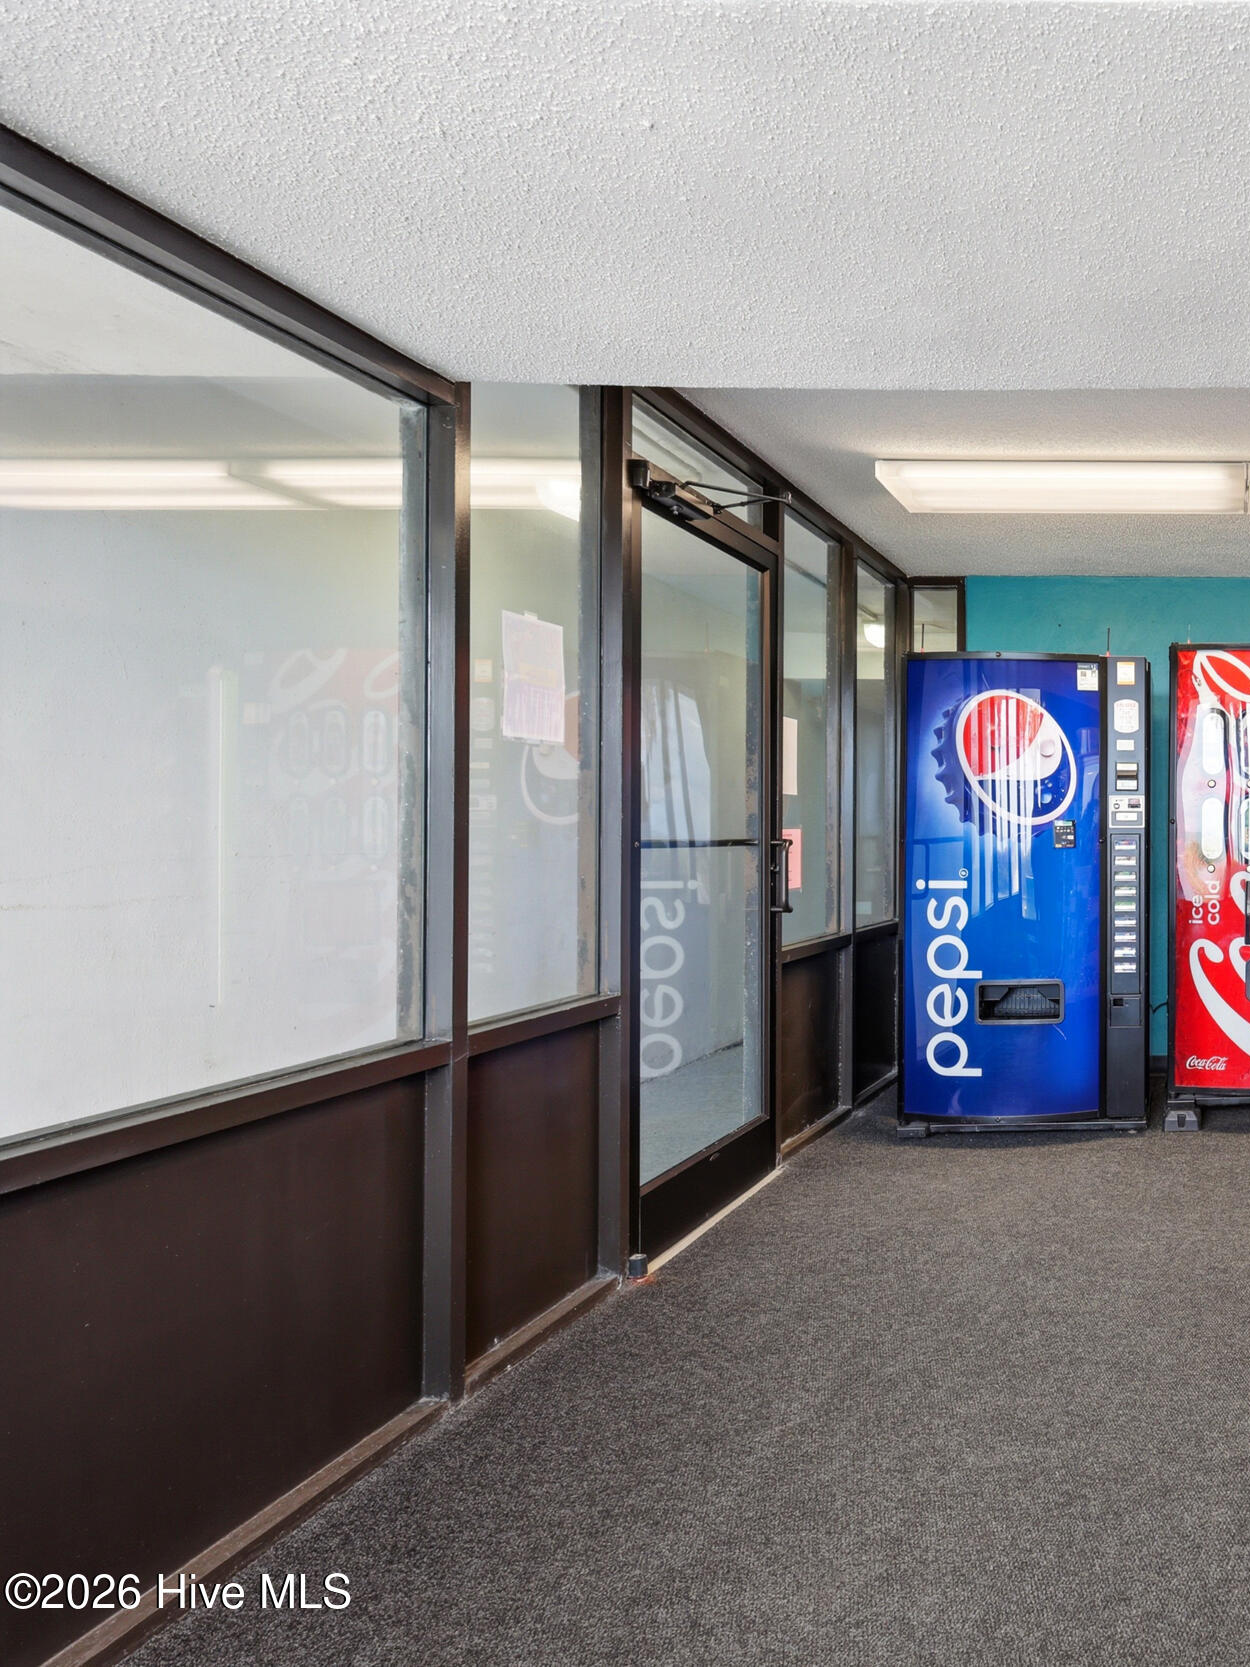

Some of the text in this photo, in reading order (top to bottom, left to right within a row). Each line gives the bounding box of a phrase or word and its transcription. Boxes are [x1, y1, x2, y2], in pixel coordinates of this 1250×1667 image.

[1188, 895, 1204, 924] ice
[1204, 880, 1220, 926] cold
[916, 879, 983, 1077] pepsi
[1186, 1055, 1228, 1071] Coca-Cola
